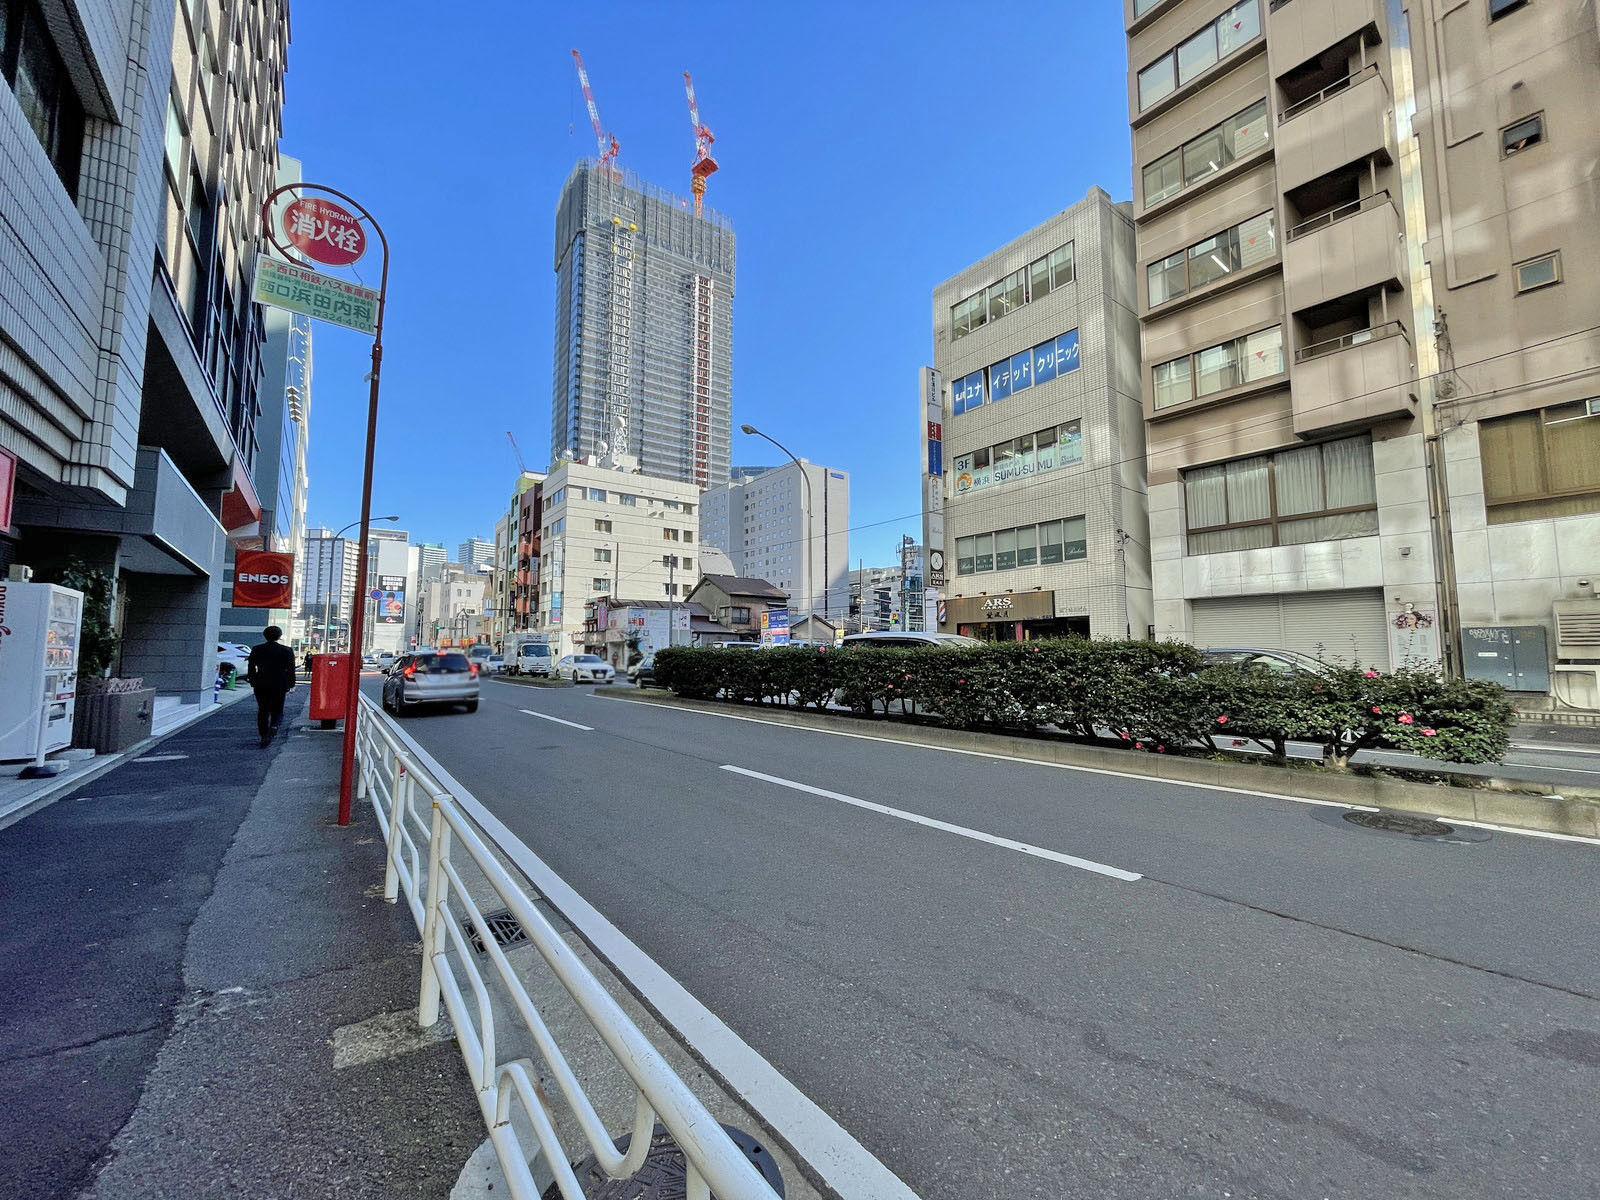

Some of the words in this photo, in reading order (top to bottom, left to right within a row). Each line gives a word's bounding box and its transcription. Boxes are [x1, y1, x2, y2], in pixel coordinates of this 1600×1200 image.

[300, 201, 317, 213] FIRE
[319, 207, 355, 225] HYDRANT
[290, 209, 361, 254] 消火栓
[260, 280, 371, 322] 西口浜田内科
[957, 458, 971, 471] 3F
[973, 474, 990, 487] 横浜
[238, 573, 289, 584] ENEOS
[983, 597, 1012, 607] ARS
[762, 613, 768, 624] P
